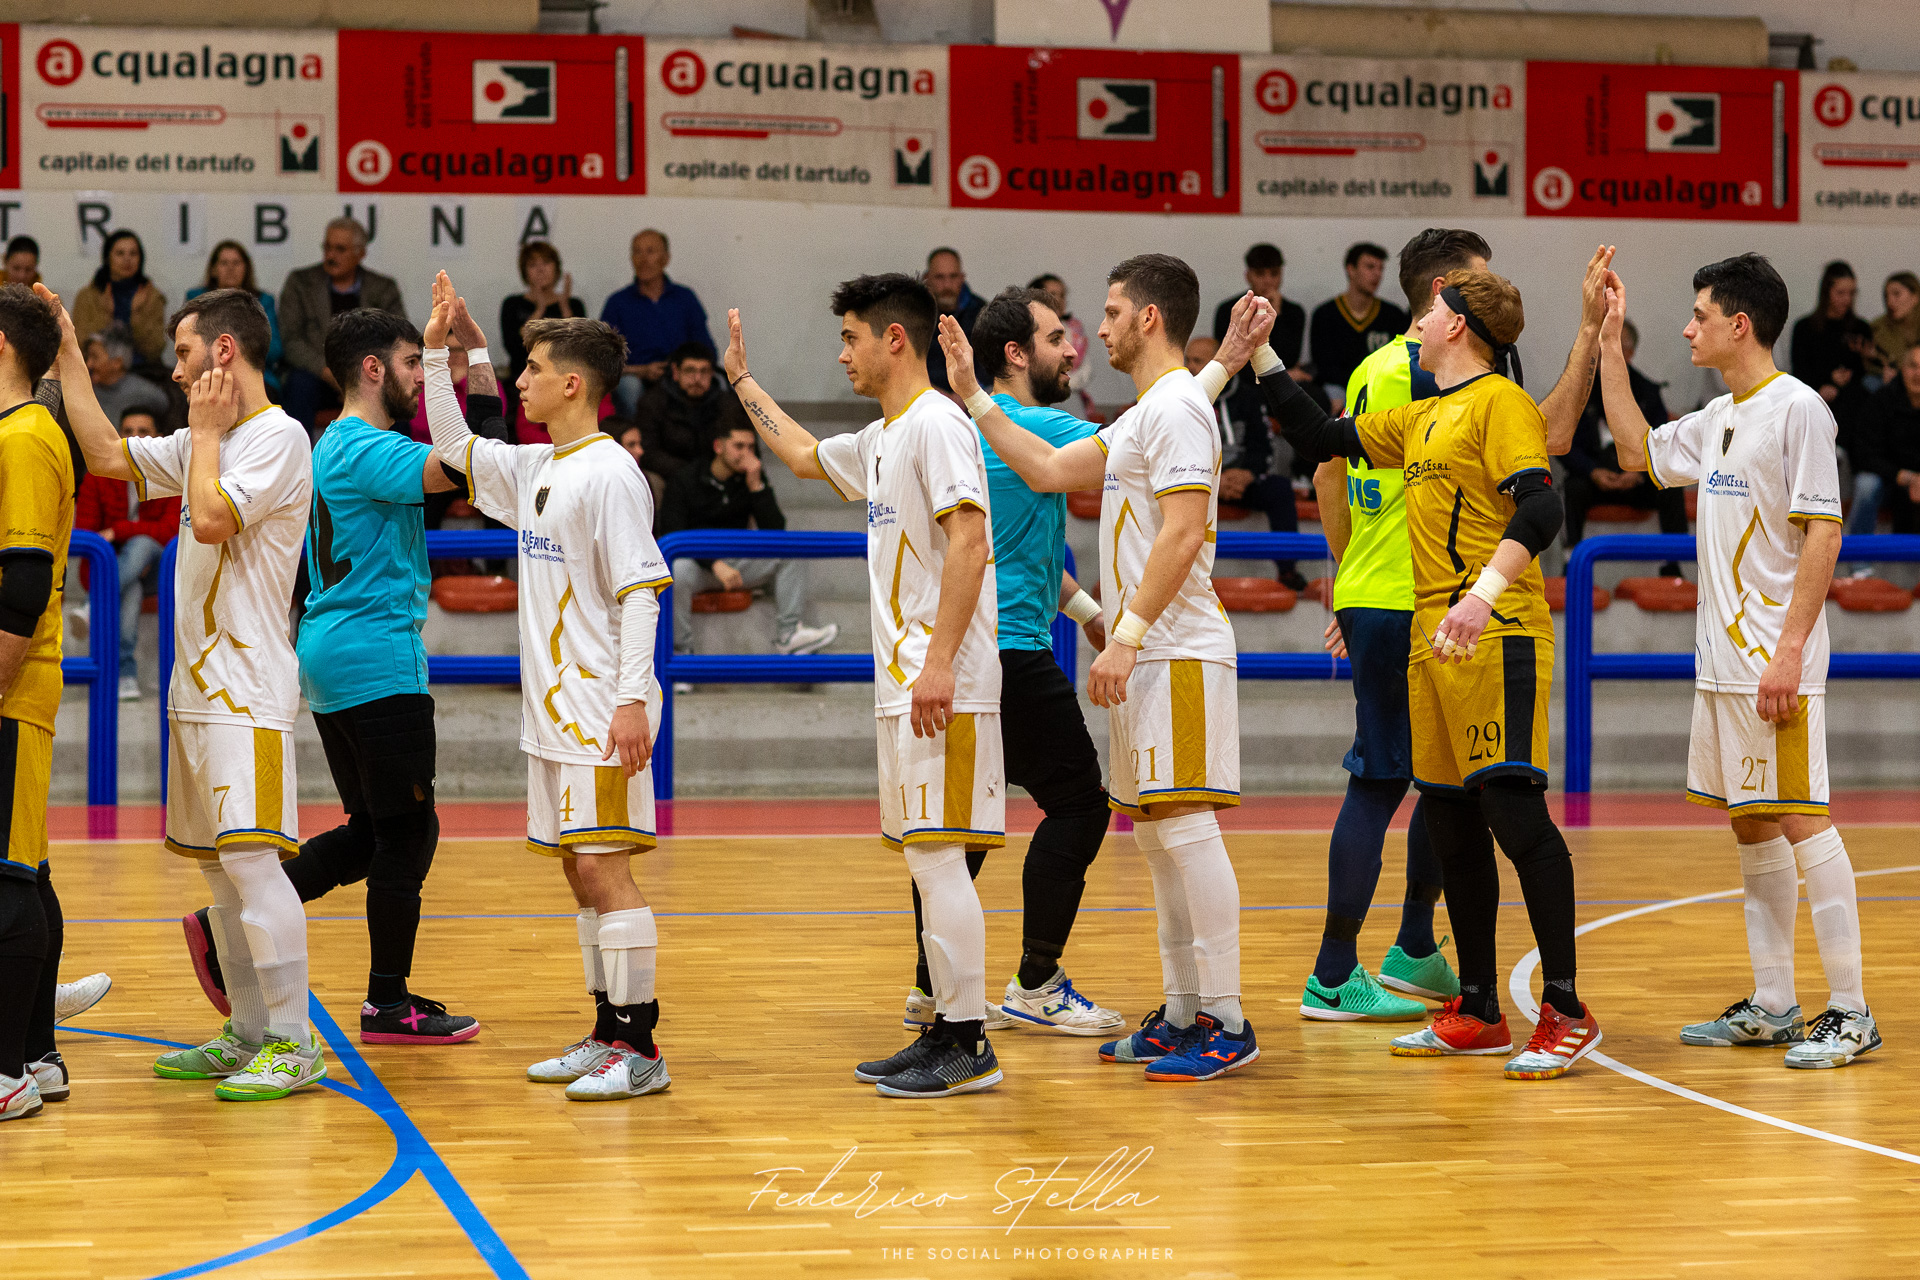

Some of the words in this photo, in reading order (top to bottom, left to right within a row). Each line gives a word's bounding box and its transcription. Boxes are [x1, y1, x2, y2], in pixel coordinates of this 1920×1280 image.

[43, 40, 323, 86] acqualagna
[669, 56, 936, 100] acqualagna
[1262, 75, 1513, 116] acqualagna
[39, 152, 129, 174] capitale
[135, 152, 170, 172] del
[177, 153, 255, 173] tartufo
[356, 147, 604, 184] acqualagna
[664, 160, 751, 181] capitale
[756, 162, 790, 180] del
[795, 163, 871, 184] tartufo
[967, 163, 1201, 199] acqualagna
[1257, 177, 1339, 198] capitale
[1344, 178, 1376, 196] del
[1380, 179, 1453, 198] tartufo
[1542, 174, 1762, 210] acqualagna
[1466, 720, 1501, 761] 29
[1130, 745, 1160, 786] 21
[1740, 756, 1767, 793] 27
[212, 785, 230, 823] 7
[559, 784, 574, 822] 4
[899, 782, 931, 820] 11
